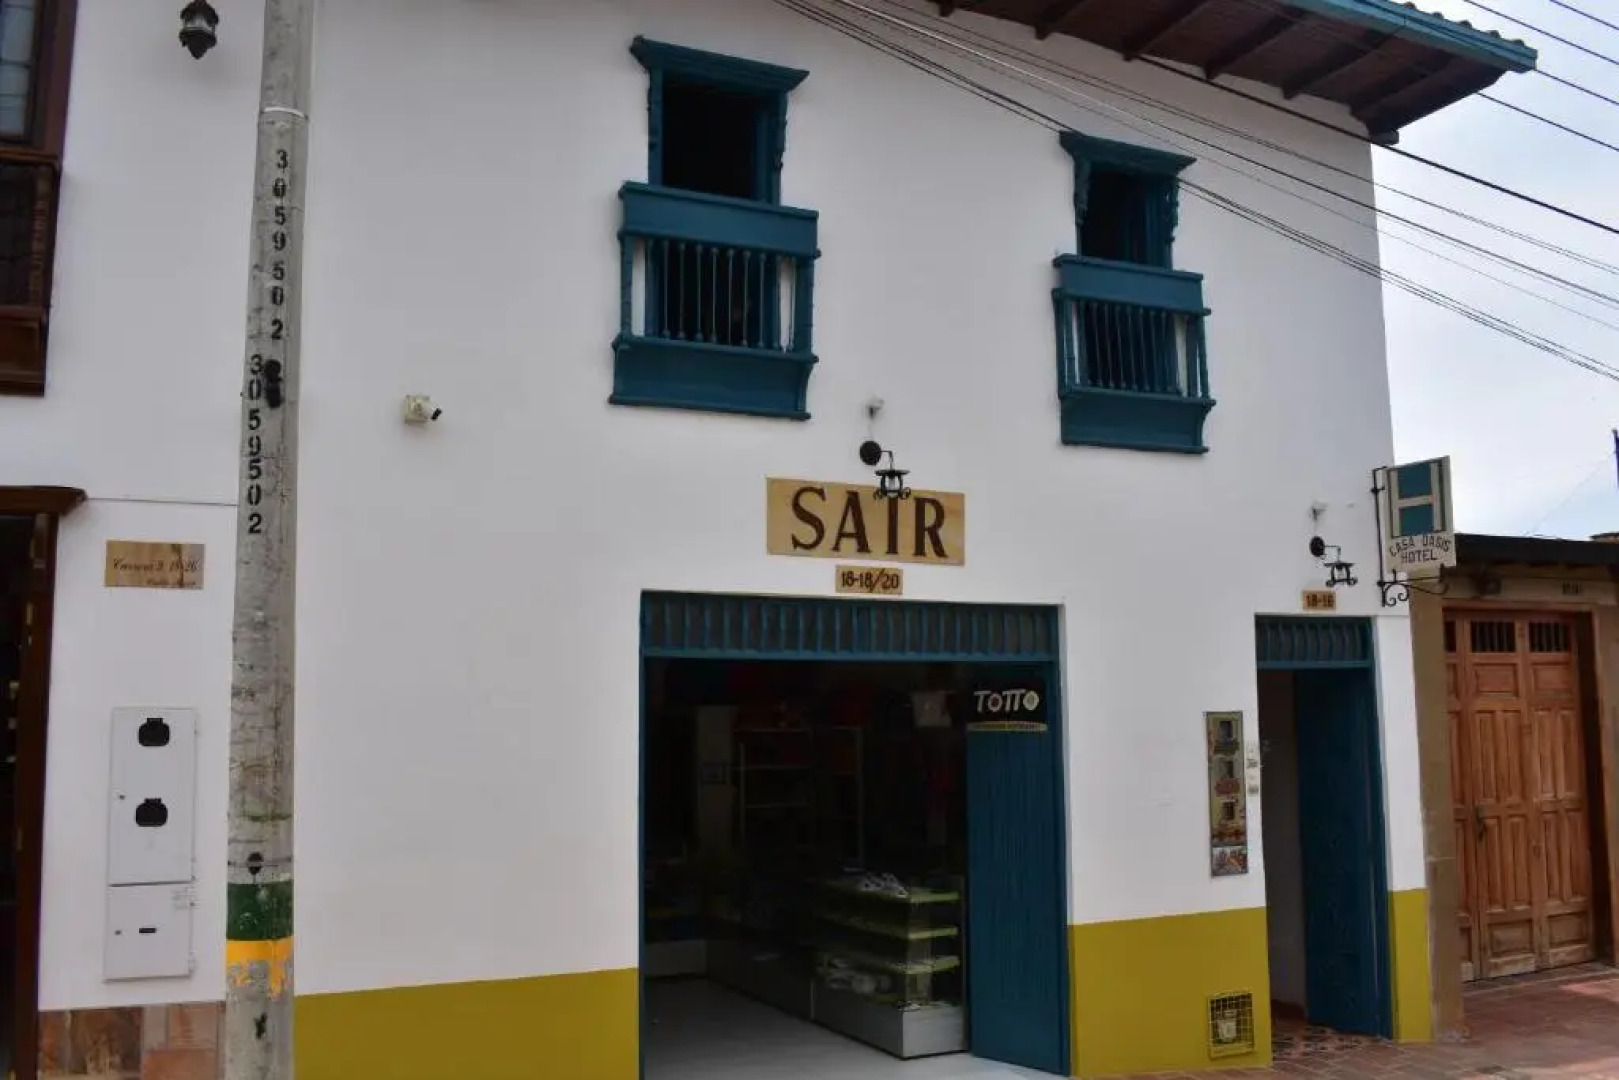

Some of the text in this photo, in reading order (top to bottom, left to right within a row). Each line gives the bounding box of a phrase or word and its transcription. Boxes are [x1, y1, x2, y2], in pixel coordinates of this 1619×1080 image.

[791, 485, 948, 558] SAIR
[1389, 537, 1416, 558] CASA
[1401, 549, 1438, 563] HOTEL
[973, 688, 1040, 713] TOTTO
